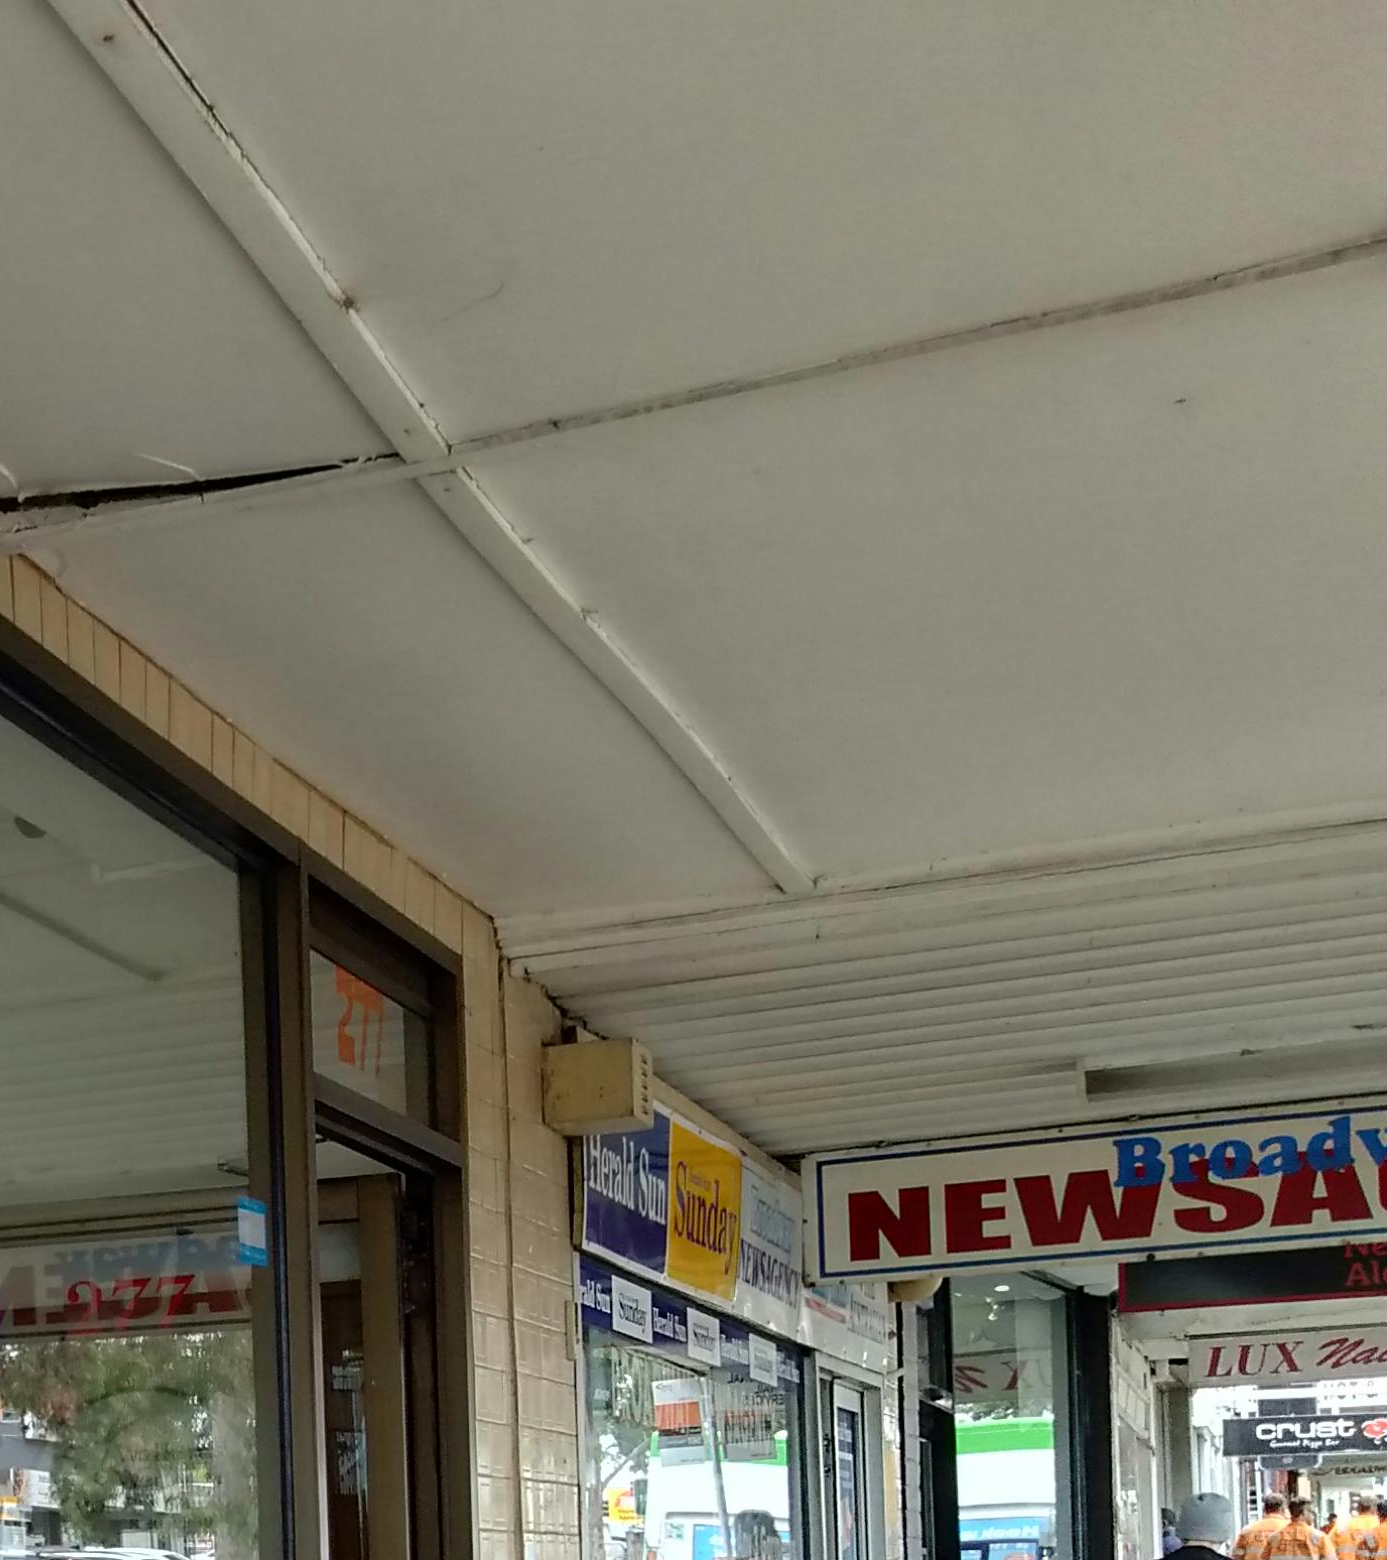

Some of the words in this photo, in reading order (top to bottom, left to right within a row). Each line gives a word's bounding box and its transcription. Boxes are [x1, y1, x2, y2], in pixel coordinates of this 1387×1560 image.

[588, 1133, 634, 1211] Herald
[638, 1148, 667, 1225] Sun
[848, 1150, 1387, 1263] NEWSA
[674, 1161, 738, 1275] Sunday
[739, 1237, 801, 1311] NEWSAGENCY
[618, 1293, 647, 1335] Sunday
[1204, 1341, 1304, 1378] LUX
[1256, 1418, 1358, 1440] crust
